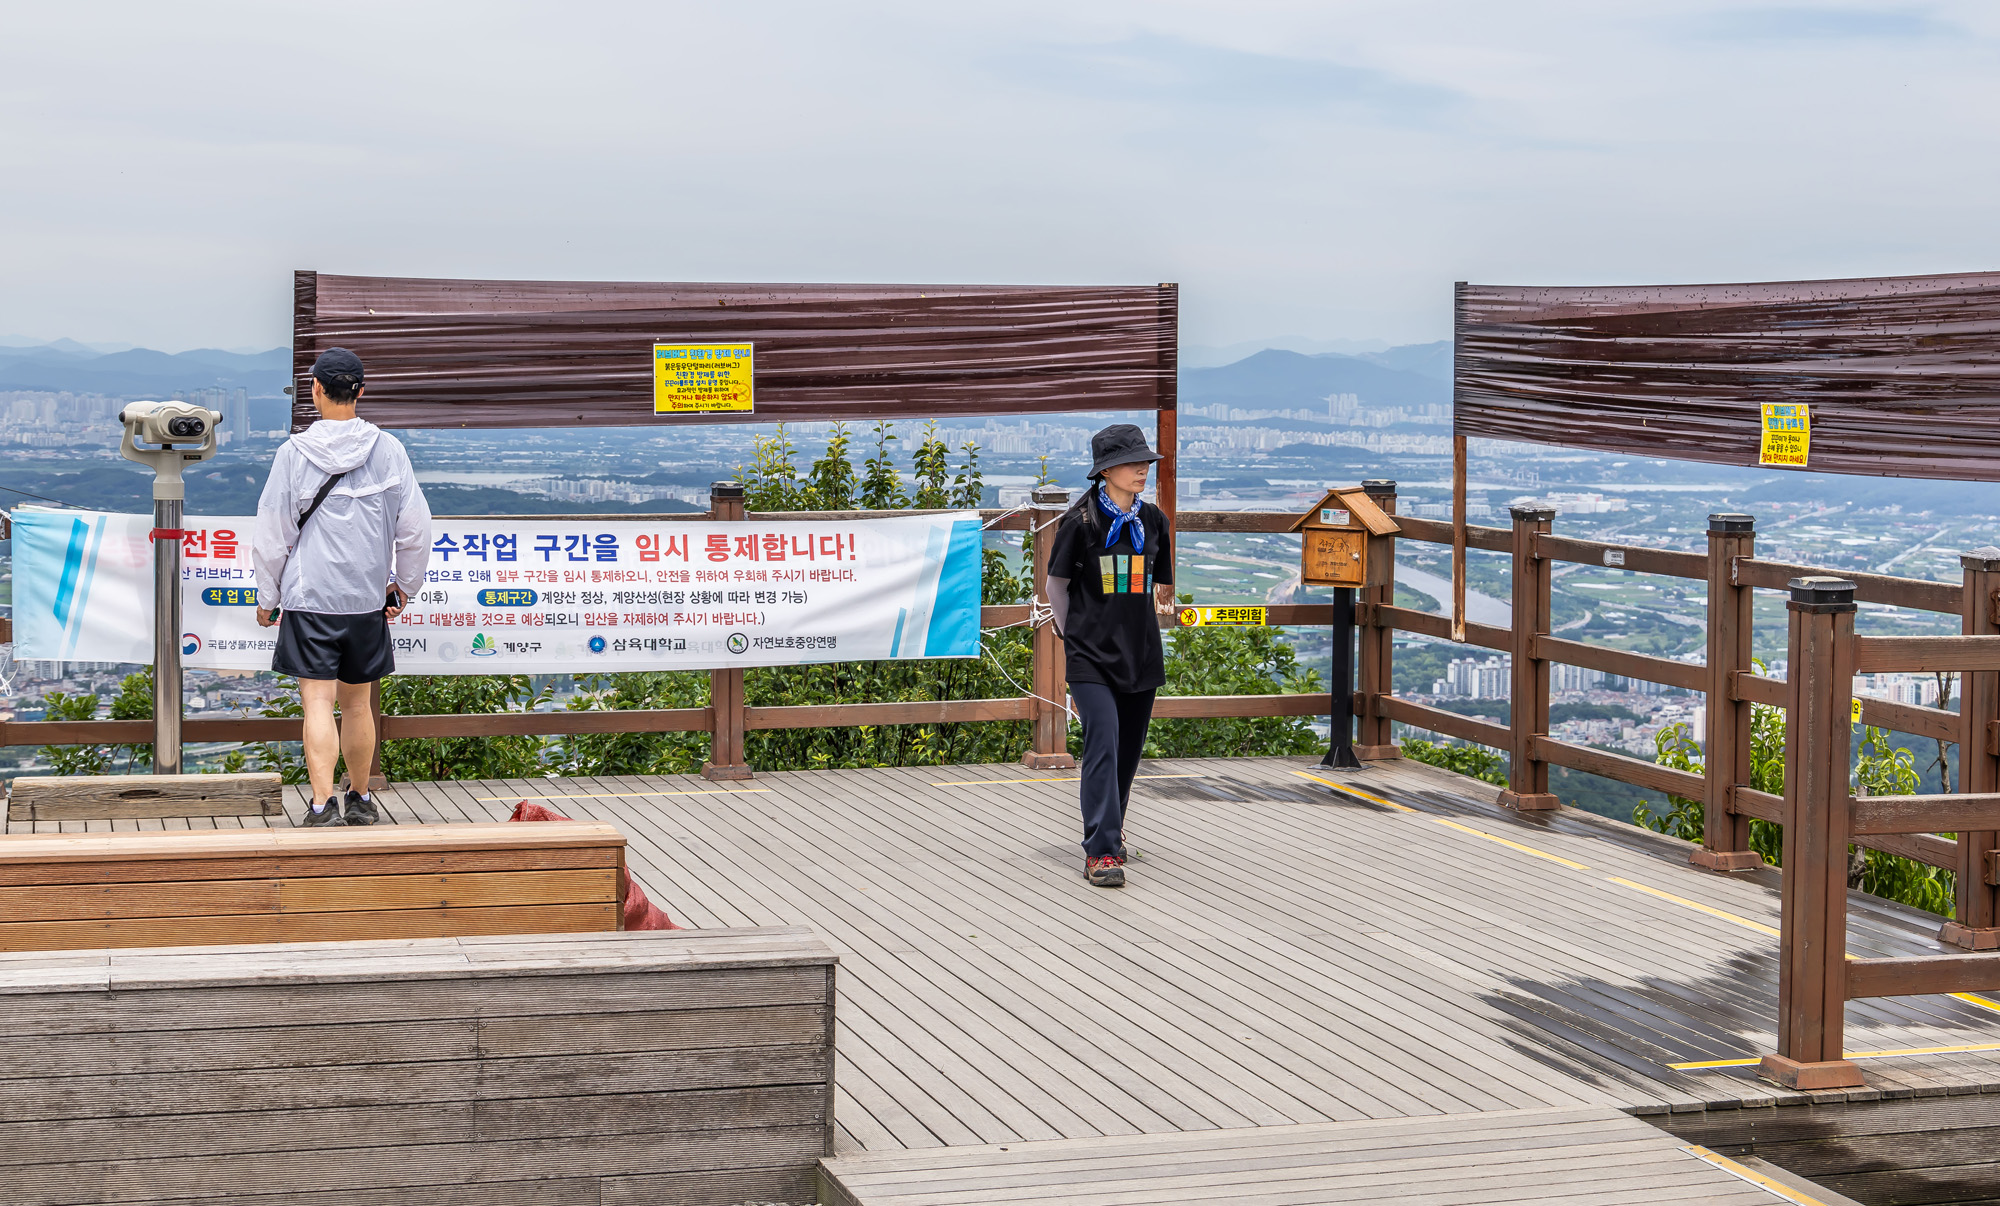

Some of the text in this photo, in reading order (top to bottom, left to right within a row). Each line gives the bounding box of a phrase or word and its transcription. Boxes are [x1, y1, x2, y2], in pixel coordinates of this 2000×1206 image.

[656, 348, 750, 360] 러브버그 친환경 방제 안내
[676, 371, 694, 379] 친환경
[697, 371, 715, 379] 방제를
[668, 394, 693, 402] 만지거나
[1785, 445, 1789, 453] 수
[1773, 454, 1788, 463] 만지지
[1789, 454, 1807, 464] 마세요!
[149, 529, 238, 558] 전을
[534, 533, 619, 561] 구간을
[635, 533, 689, 561] 임시
[704, 533, 856, 562] 통제합니다!
[196, 566, 244, 581] 러브버그
[420, 569, 857, 583] 업으로 인해 일부 구간을 임시 통제하오니, 안전을 위하여 우회해 주시기 바랍니다.
[421, 590, 448, 604] 이후)
[485, 591, 532, 604] 통제구간
[541, 591, 576, 604] 계양산
[581, 591, 607, 605] 정상,
[613, 591, 685, 605] 계양산성(현장
[690, 591, 723, 604] 상황에
[728, 591, 750, 604] 따라
[755, 591, 777, 604] 변경
[782, 591, 808, 604] 가능)
[401, 612, 424, 626] 버그
[429, 612, 476, 627] 대발생할
[482, 612, 516, 626] 것으로
[522, 612, 579, 626] 예상되오니
[585, 612, 618, 626] 입산을
[623, 612, 669, 626] 자제하여
[673, 612, 707, 626] 주시기
[713, 612, 765, 626] 바랍니다.)
[1216, 608, 1261, 621] 추락위험
[208, 639, 276, 653] 국립생물자원관
[503, 641, 542, 653] 계양구
[613, 637, 687, 652] 삼육대학교
[752, 636, 837, 650] 자연보호중앙연맹
